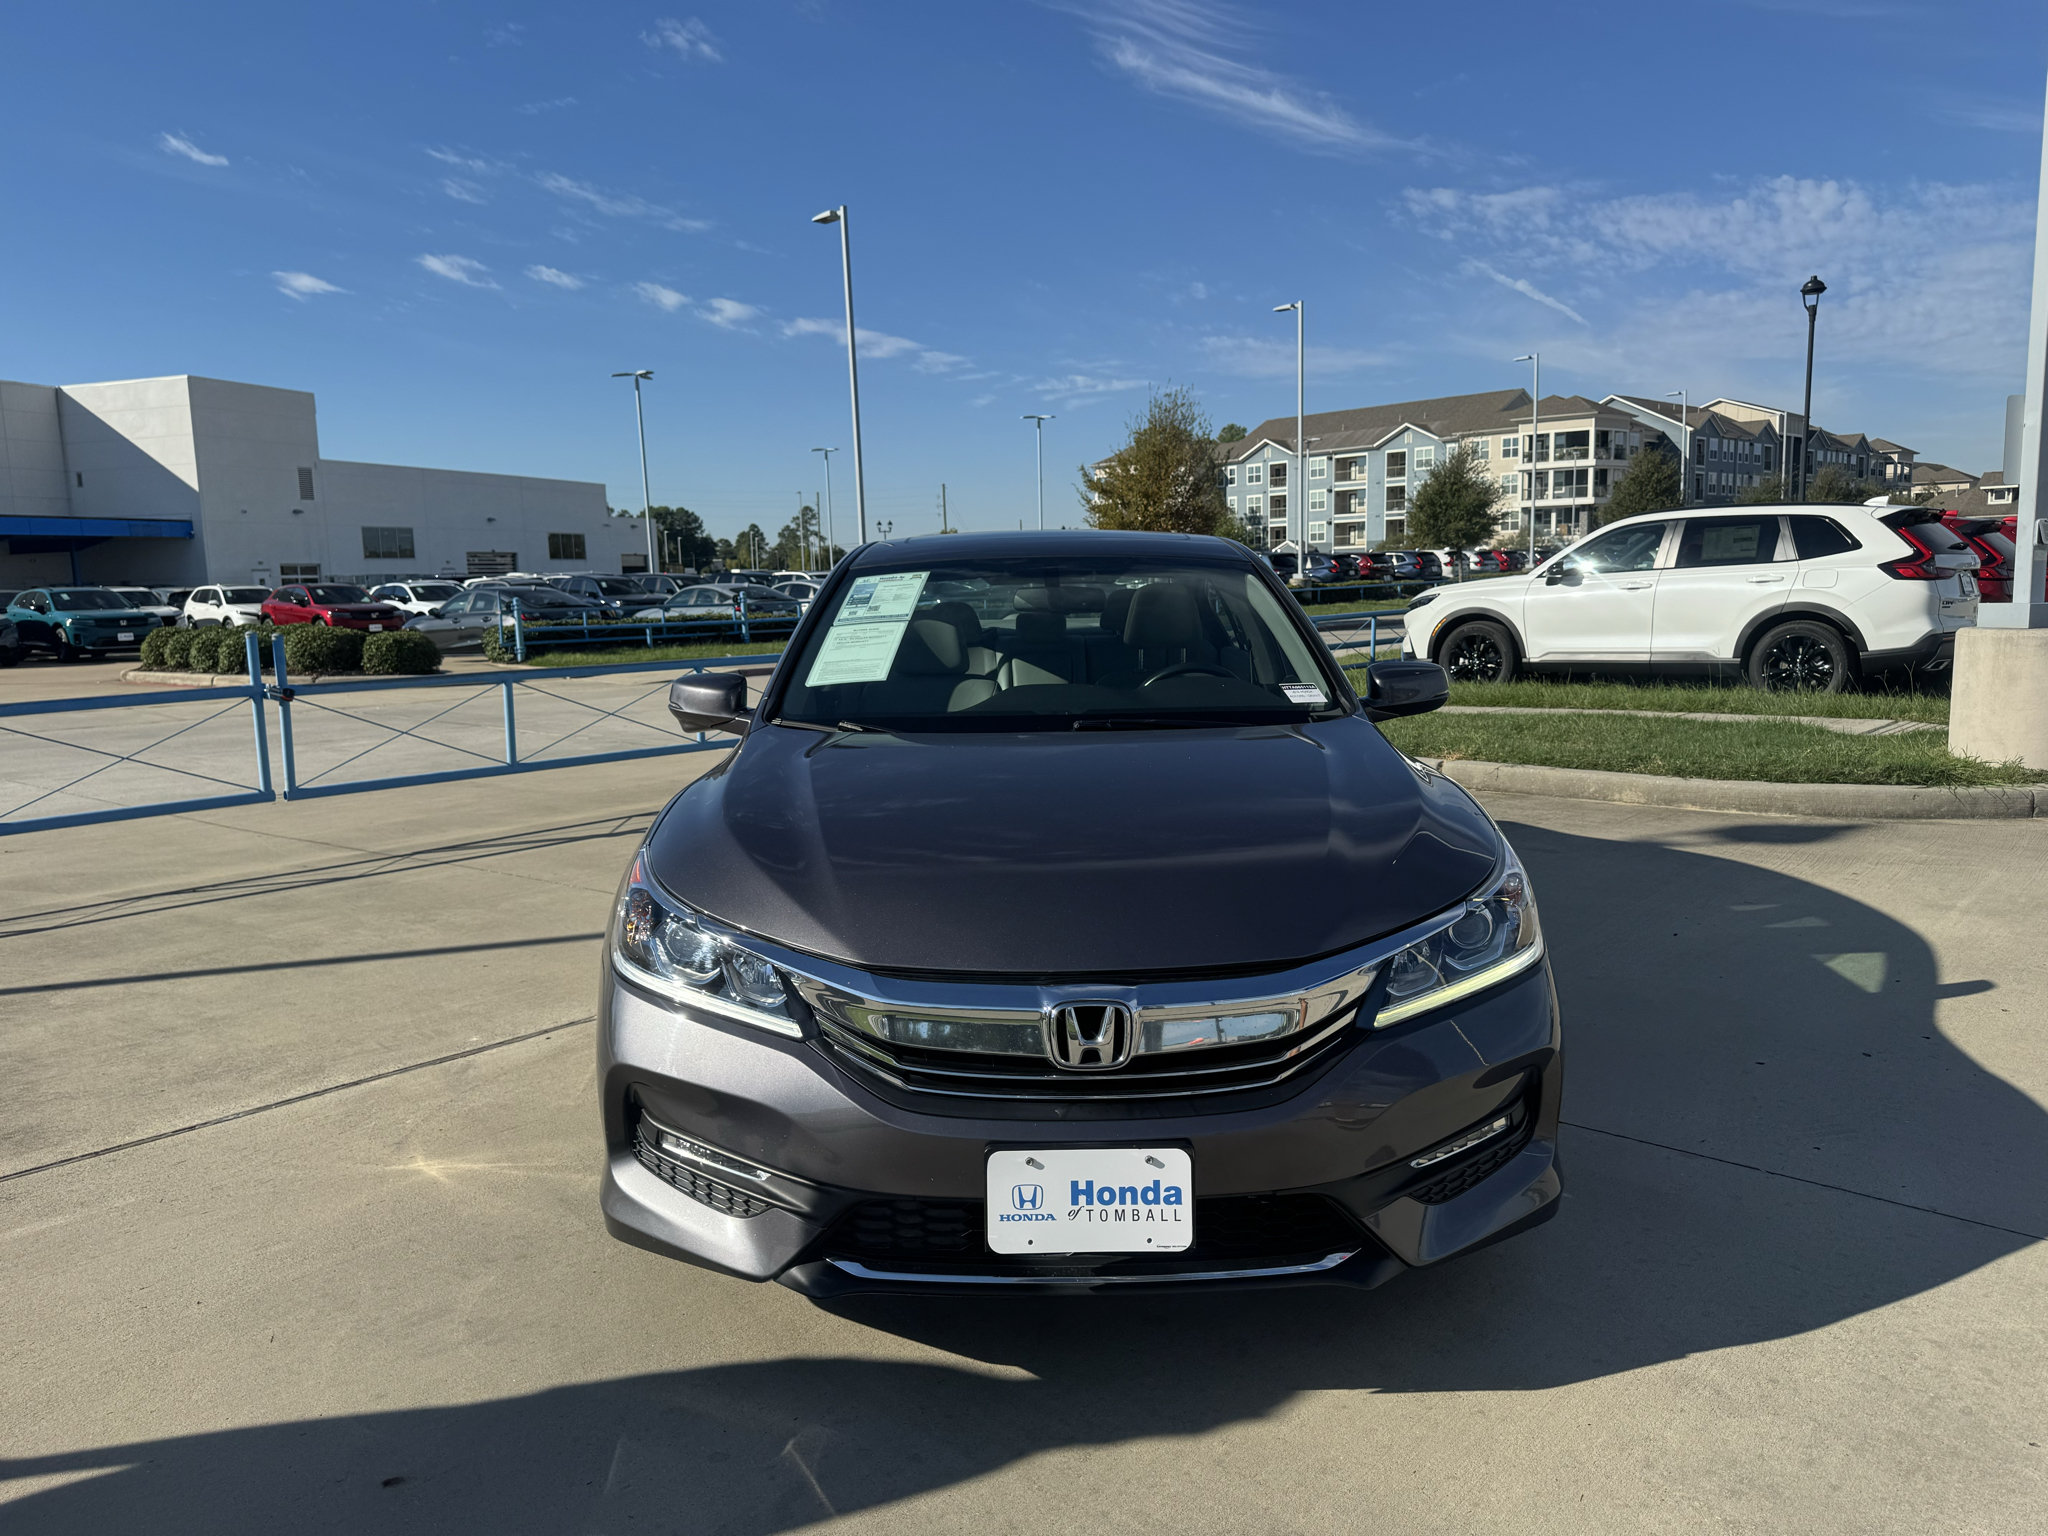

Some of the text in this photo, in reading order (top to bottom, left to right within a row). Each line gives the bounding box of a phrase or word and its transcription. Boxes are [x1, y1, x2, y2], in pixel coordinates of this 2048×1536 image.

[1070, 1179, 1183, 1206] Honda
[999, 1213, 1057, 1222] HONDA
[1067, 1206, 1182, 1222] of TOMBALL
